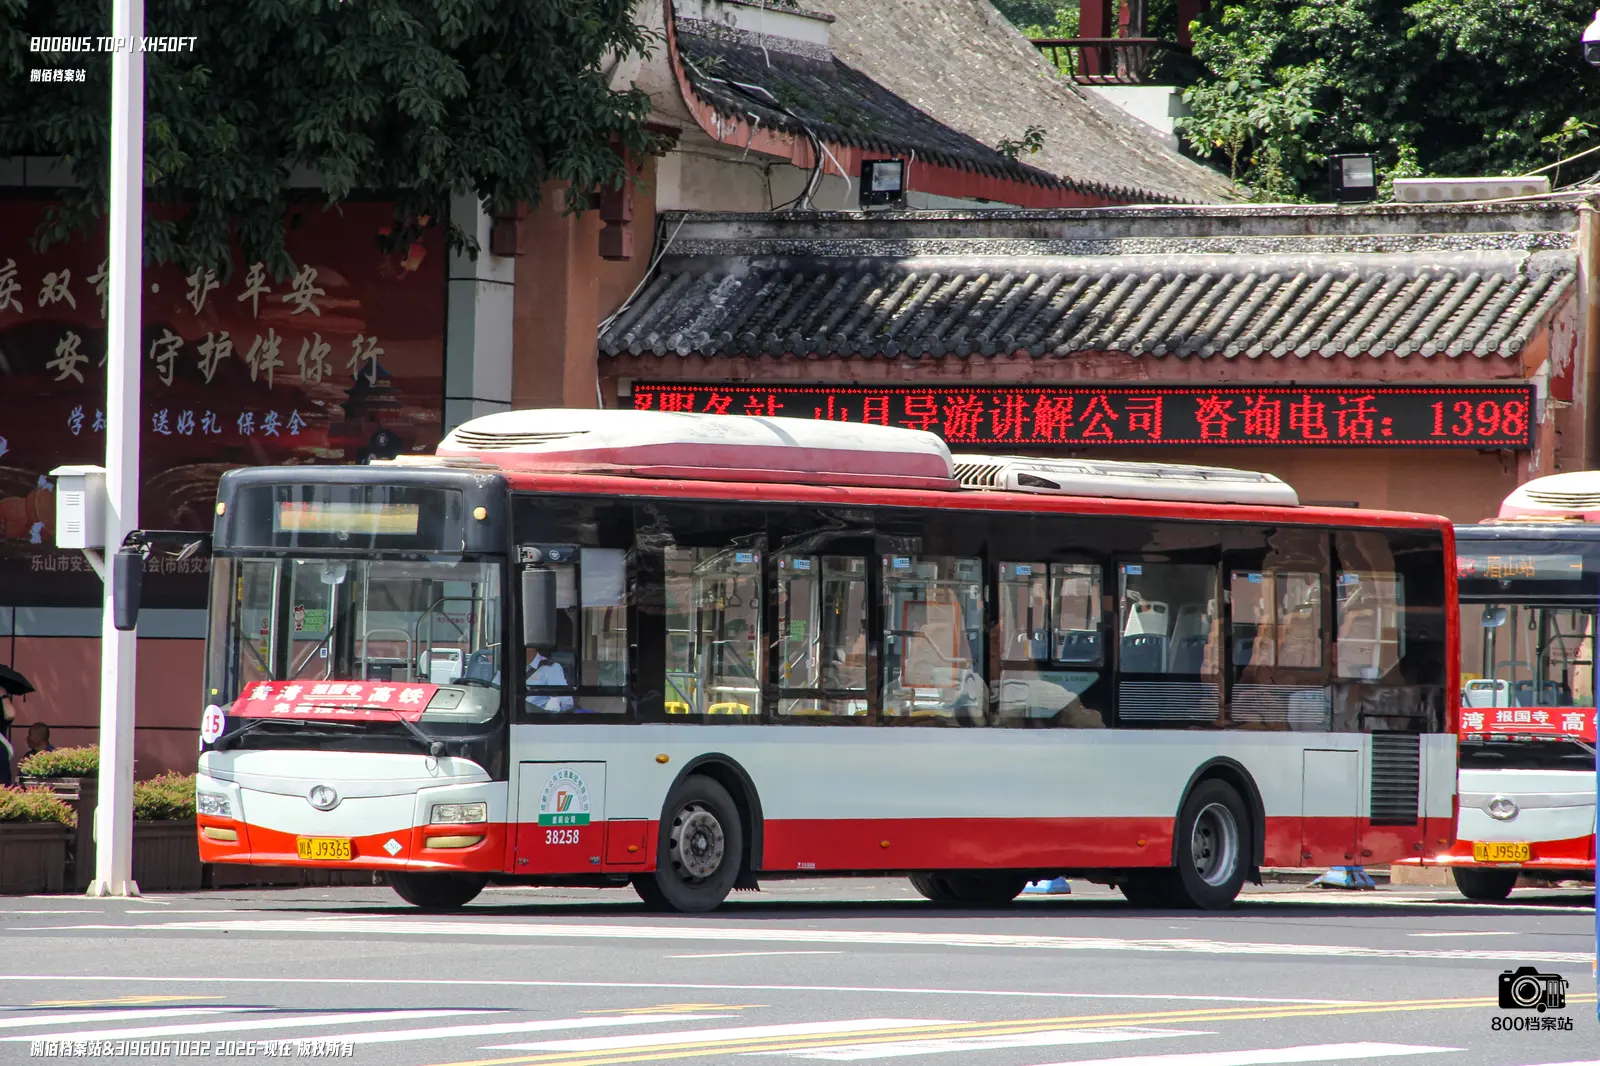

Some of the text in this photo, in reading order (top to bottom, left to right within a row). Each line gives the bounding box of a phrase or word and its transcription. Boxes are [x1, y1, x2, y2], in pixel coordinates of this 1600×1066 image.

[46, 327, 386, 390] 安守护伴你行
[236, 409, 308, 437] 保安全
[205, 714, 221, 734] 15
[1496, 710, 1549, 724] 报国寺
[545, 829, 580, 845] 38258
